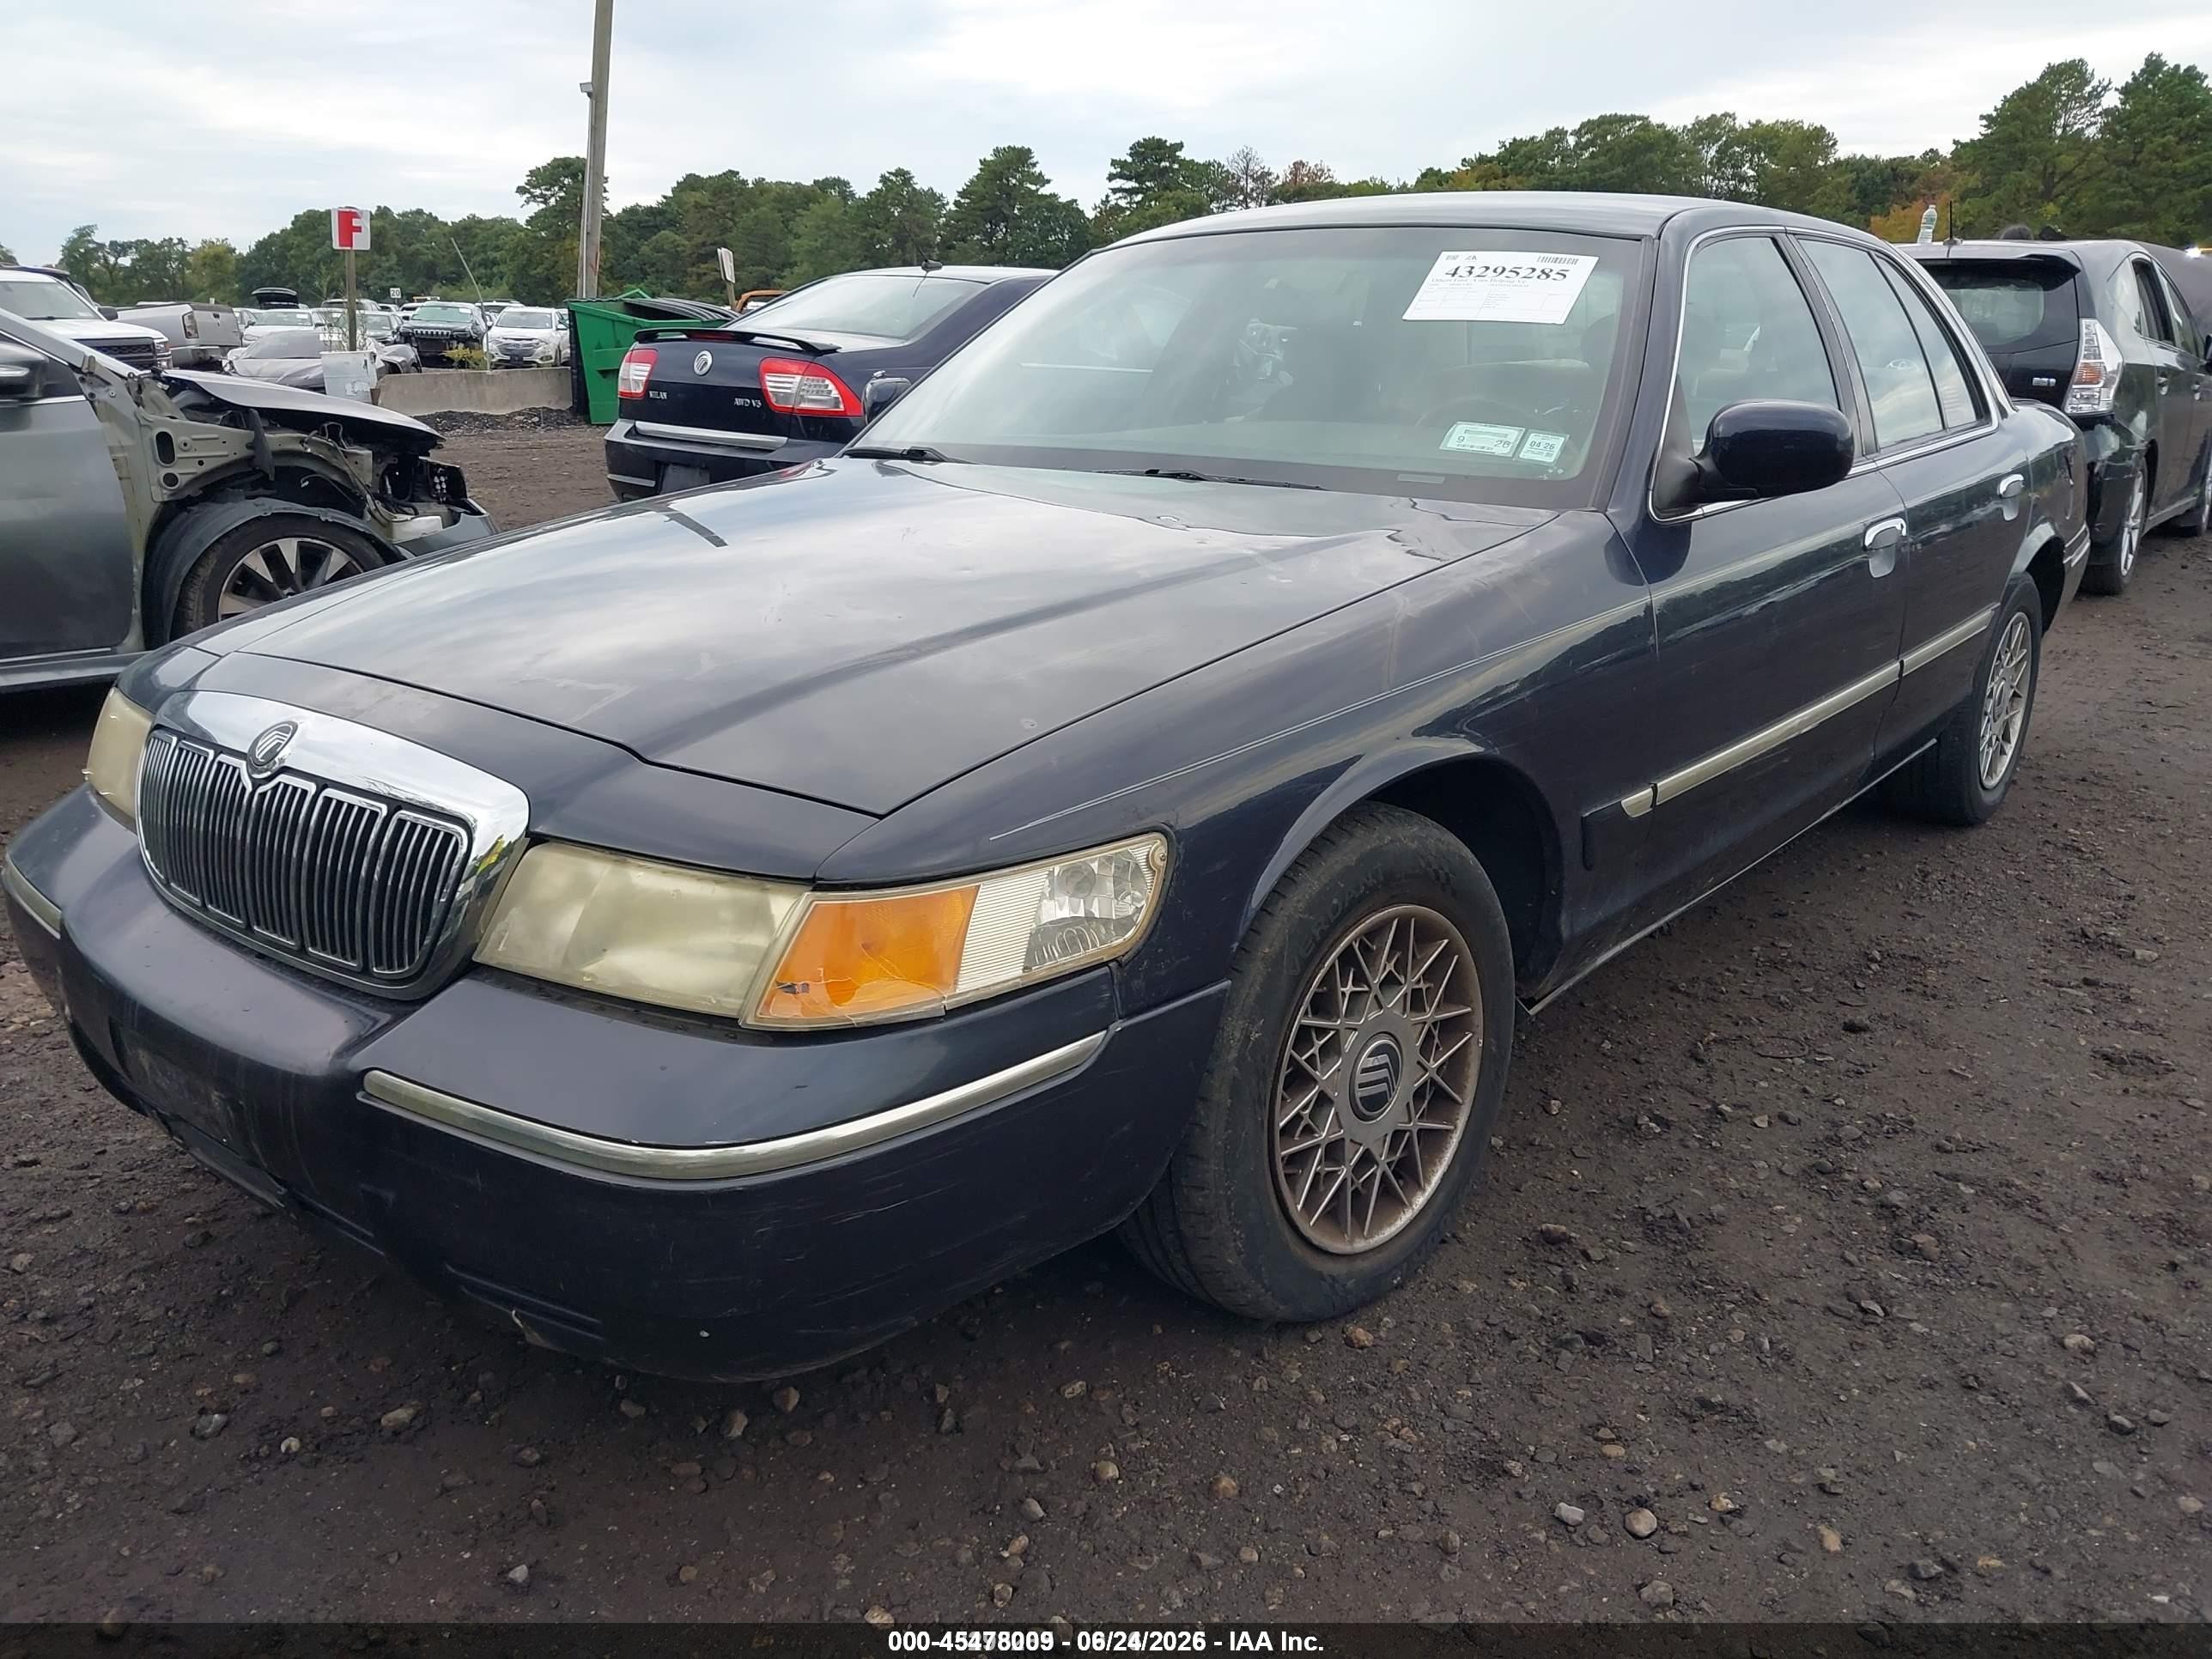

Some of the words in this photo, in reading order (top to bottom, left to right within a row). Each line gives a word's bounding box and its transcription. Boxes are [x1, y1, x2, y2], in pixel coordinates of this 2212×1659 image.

[337, 210, 362, 247] F
[1444, 265, 1571, 282] 43295285
[734, 398, 750, 407] AWD
